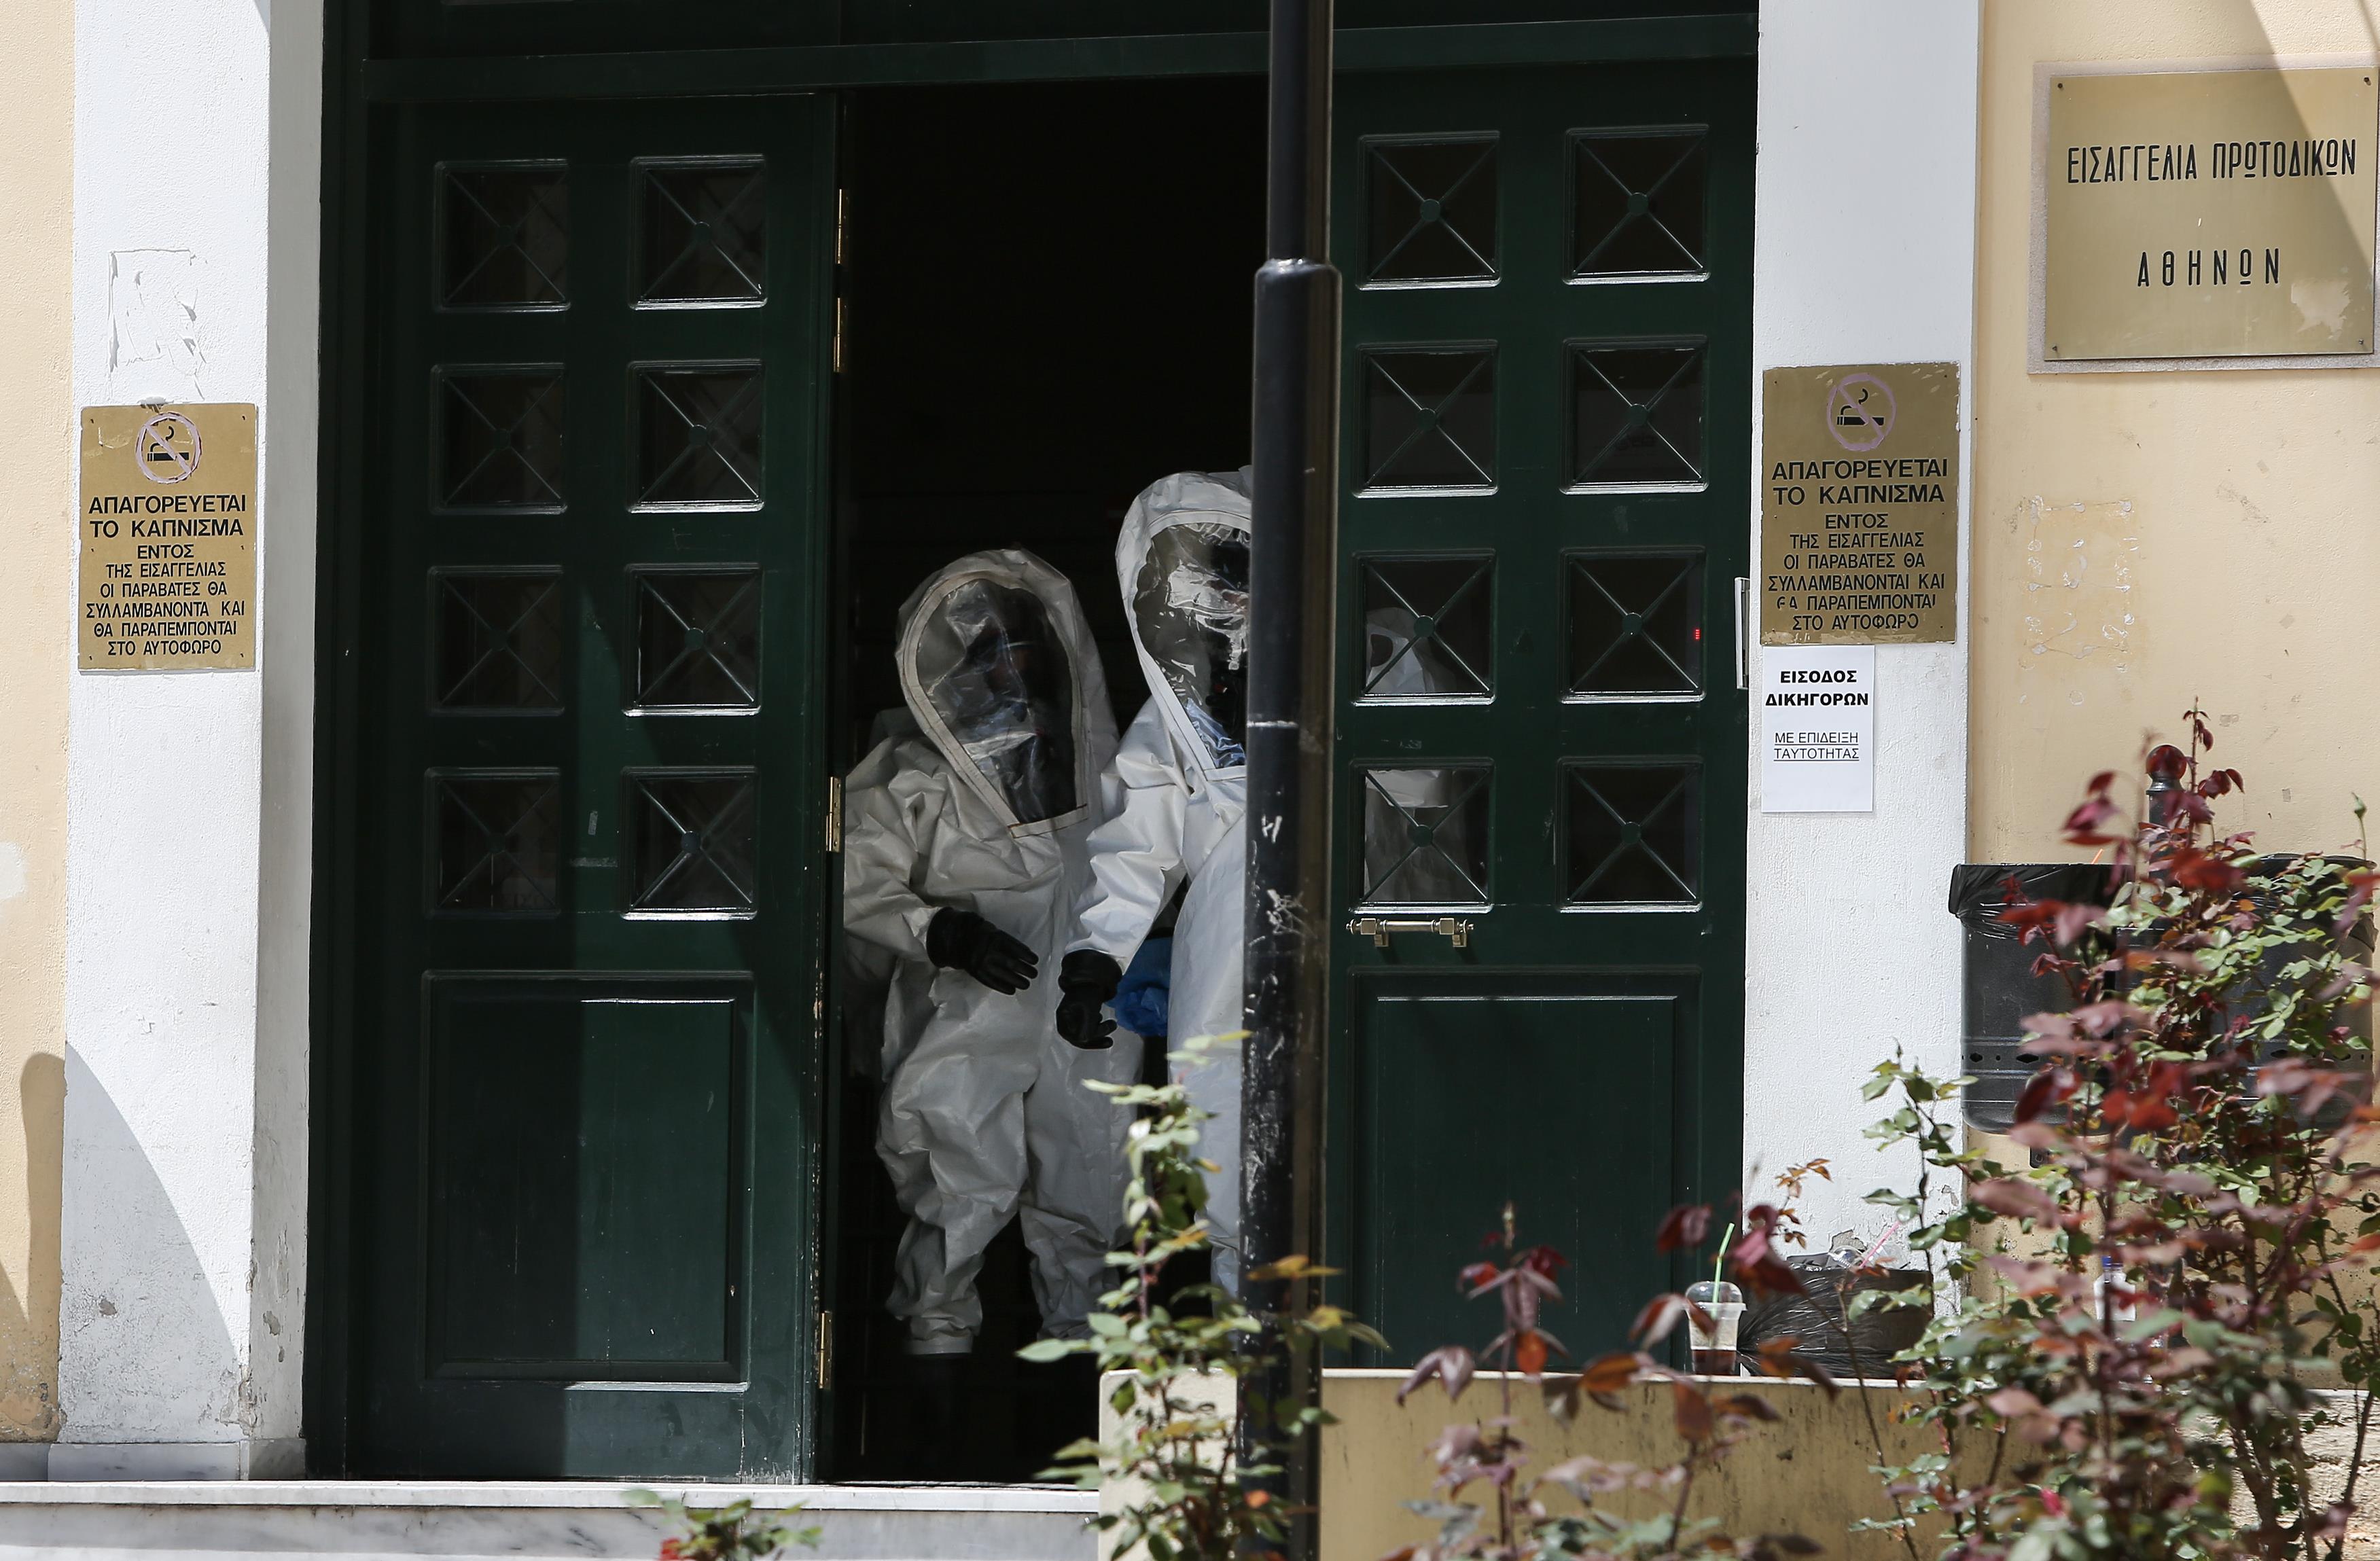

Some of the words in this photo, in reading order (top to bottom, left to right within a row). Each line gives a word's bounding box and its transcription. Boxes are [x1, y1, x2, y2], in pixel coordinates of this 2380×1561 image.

[2067, 144, 2197, 183] ΕΙΣΑΓΓΕΛΙΑ
[2212, 139, 2356, 179] ΠΡΩΤΟΔΙΚΩΝ
[2137, 248, 2279, 287] ΑΘΗΝΩΝ
[1771, 459, 1947, 480] ΑΠΑΓΟΡΕΥΕΤΑΙ
[1773, 486, 1805, 505] ΤΟ
[1819, 484, 1945, 505] ΚΑΠΝΙΣΜΑ
[88, 495, 246, 514] ΑΠΑΓΟΡΕΥΕΤΑΙ
[89, 520, 119, 538] ΤΟ
[131, 518, 244, 537] ΚΑΠΝΙΣΜΑ
[1825, 513, 1889, 529] ΕΝΤΟΣ
[1790, 534, 1819, 550] ΤΗΣ
[1828, 531, 1924, 549] ΕΙΣΑΓΓΕΛΙΑΣ
[137, 543, 194, 559] ΕΝΤΟΣ
[105, 563, 132, 579] ΤΗΣ
[140, 561, 226, 577] ΕΙΣΑΓΓΕΛΙΑΣ
[1783, 554, 1799, 570] ΟΙ
[1808, 552, 1896, 569] ΠΑΡΑΒΑΤΕΣ
[1903, 552, 1925, 569] ΘΑ
[100, 583, 114, 598] ΟΙ
[122, 581, 200, 598] ΠΑΡΑΒΑΤΕΣ
[207, 581, 228, 596] ΘΑ
[1768, 573, 1909, 592] ΣΥΛΛΑΜΒΑΝΟΝΤΑΙ
[1918, 573, 1944, 590] ΚΑΙ
[221, 600, 245, 616] ΚΑΙ
[94, 622, 113, 638] ΘΑ
[121, 620, 236, 637] ΠΑΡΑΠΕΜΠΟΝΤΑΙ
[1792, 615, 1824, 631] ΣΤΟ
[107, 641, 136, 656] ΣΤΟ
[143, 639, 221, 656] ΑΥΤΟΦΩΡΟ
[1780, 670, 1857, 683] ΕΙΣΟΔΟΣ
[1765, 693, 1868, 706] ΔΙΚΗΓΟΡΩΝ
[1775, 732, 1794, 743] ΜΕ
[1798, 732, 1858, 743] ΕΠΙΔΕΙΞΗ
[1773, 748, 1860, 759] ΤΑΥΤΟΤΗΤΑΣ
